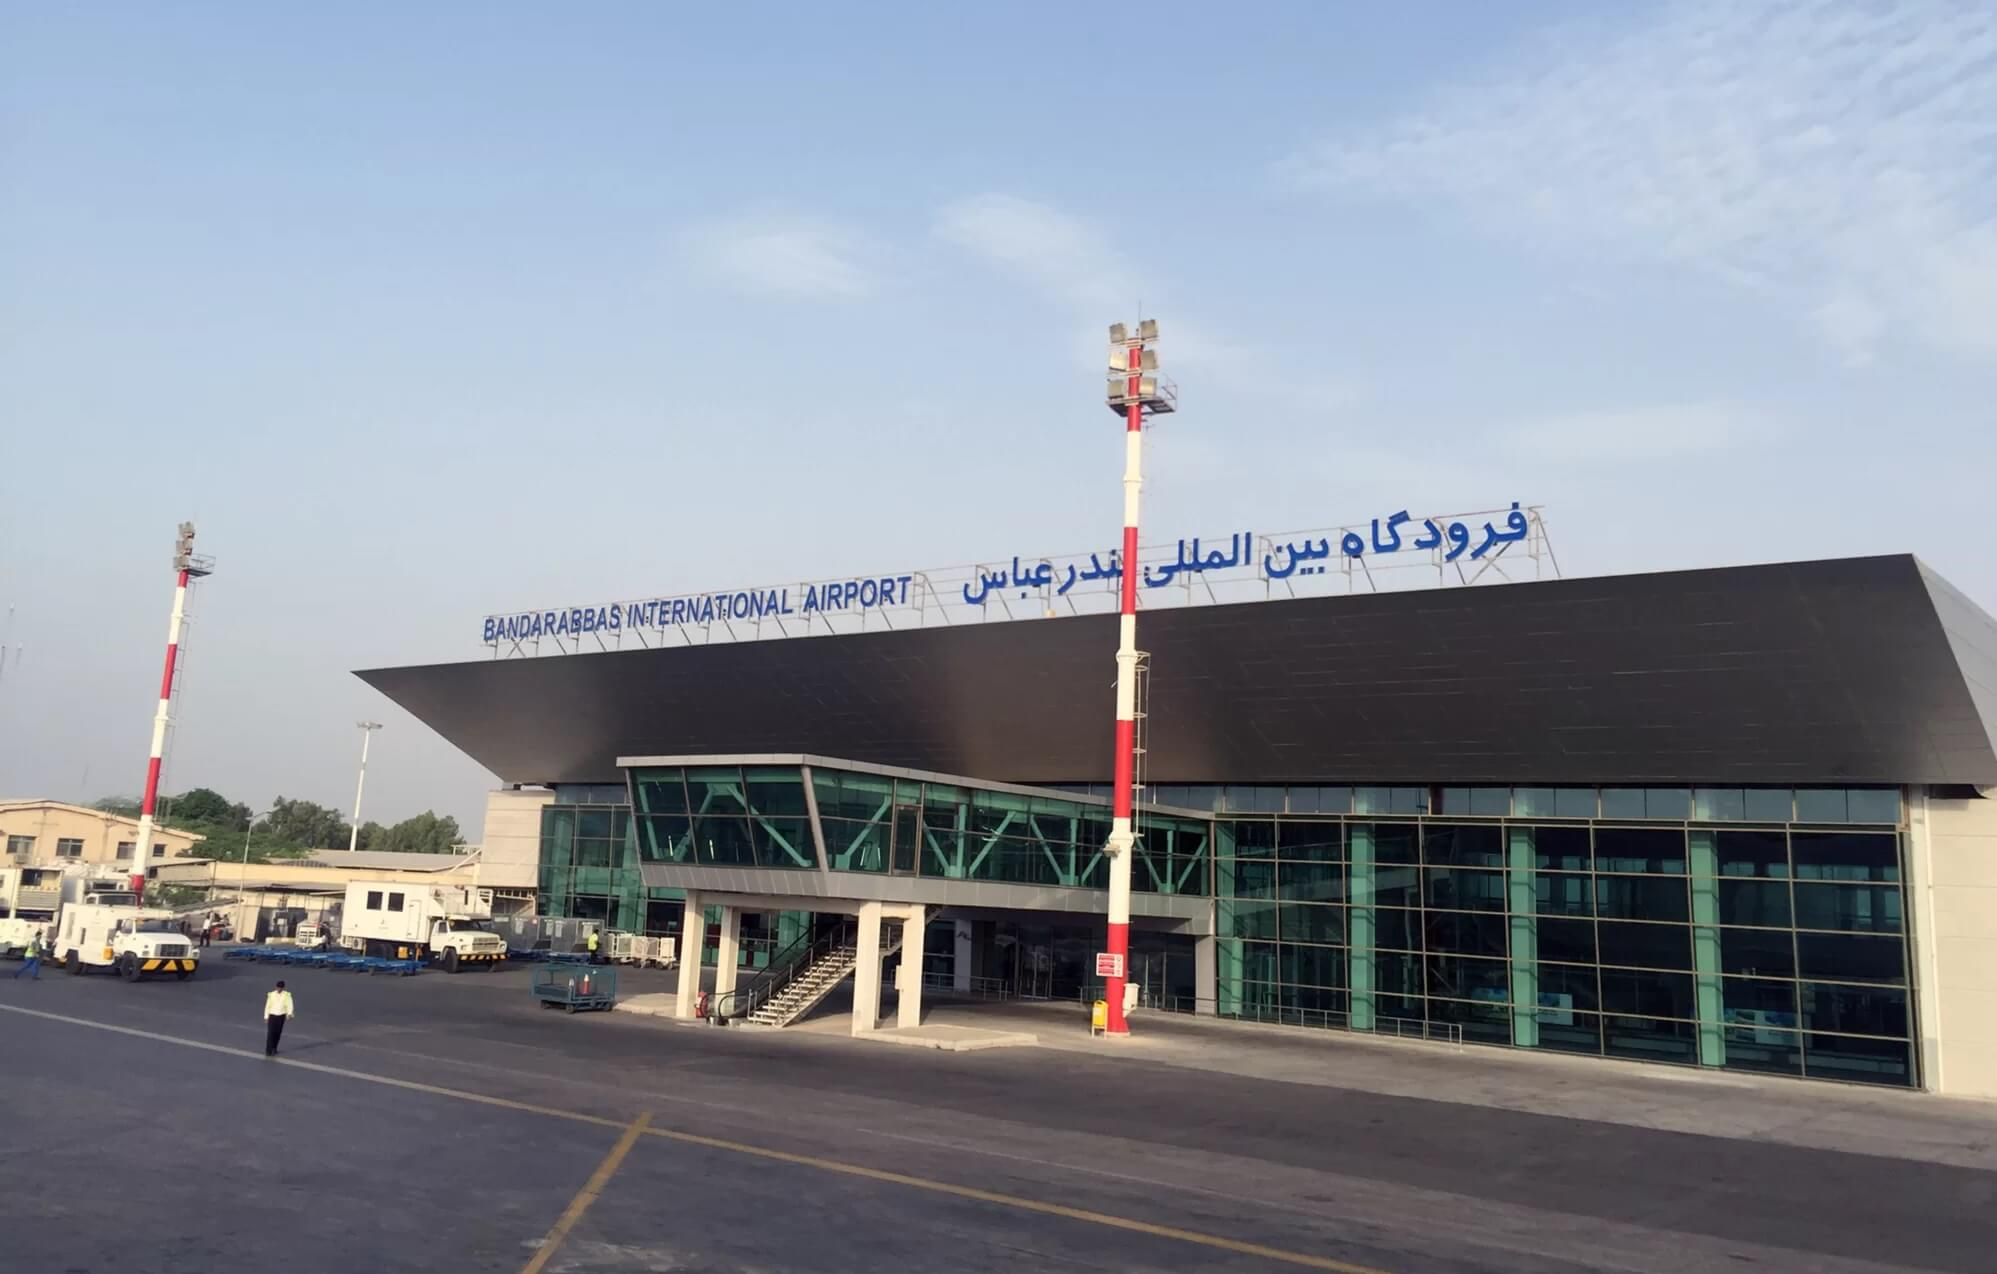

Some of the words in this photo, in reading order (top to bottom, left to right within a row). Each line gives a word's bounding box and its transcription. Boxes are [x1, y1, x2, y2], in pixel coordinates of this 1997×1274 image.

[1143, 531, 1252, 589] المللی
[1263, 538, 1330, 580] بین
[1342, 502, 1529, 562] فرودگاه
[962, 548, 1124, 606] ندرعباس
[484, 603, 621, 641] BANDARABBAS
[627, 589, 794, 627] INTERNATIONAL
[803, 576, 912, 612] AIRPORT
